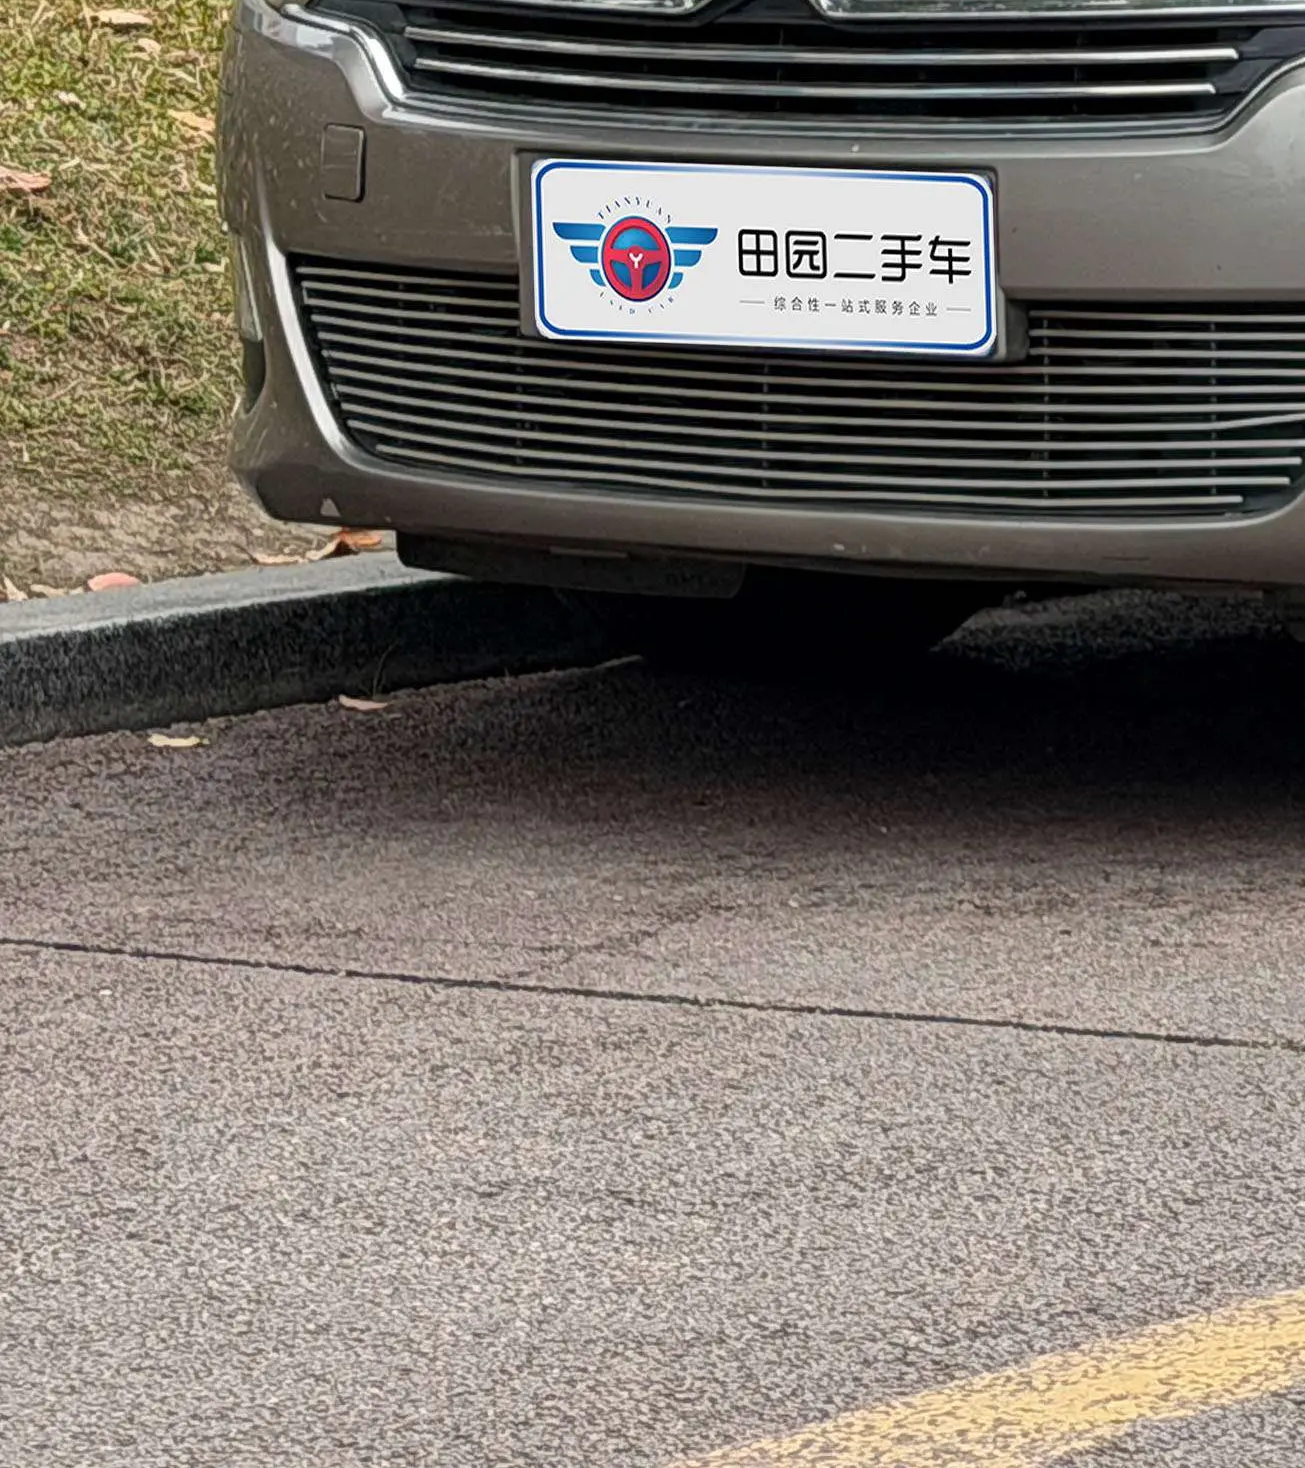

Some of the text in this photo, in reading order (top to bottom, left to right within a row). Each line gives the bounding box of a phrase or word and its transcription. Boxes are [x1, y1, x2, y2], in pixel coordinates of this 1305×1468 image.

[738, 229, 971, 284] 田园二手车
[774, 296, 938, 316] 综合性一站式服务企业
